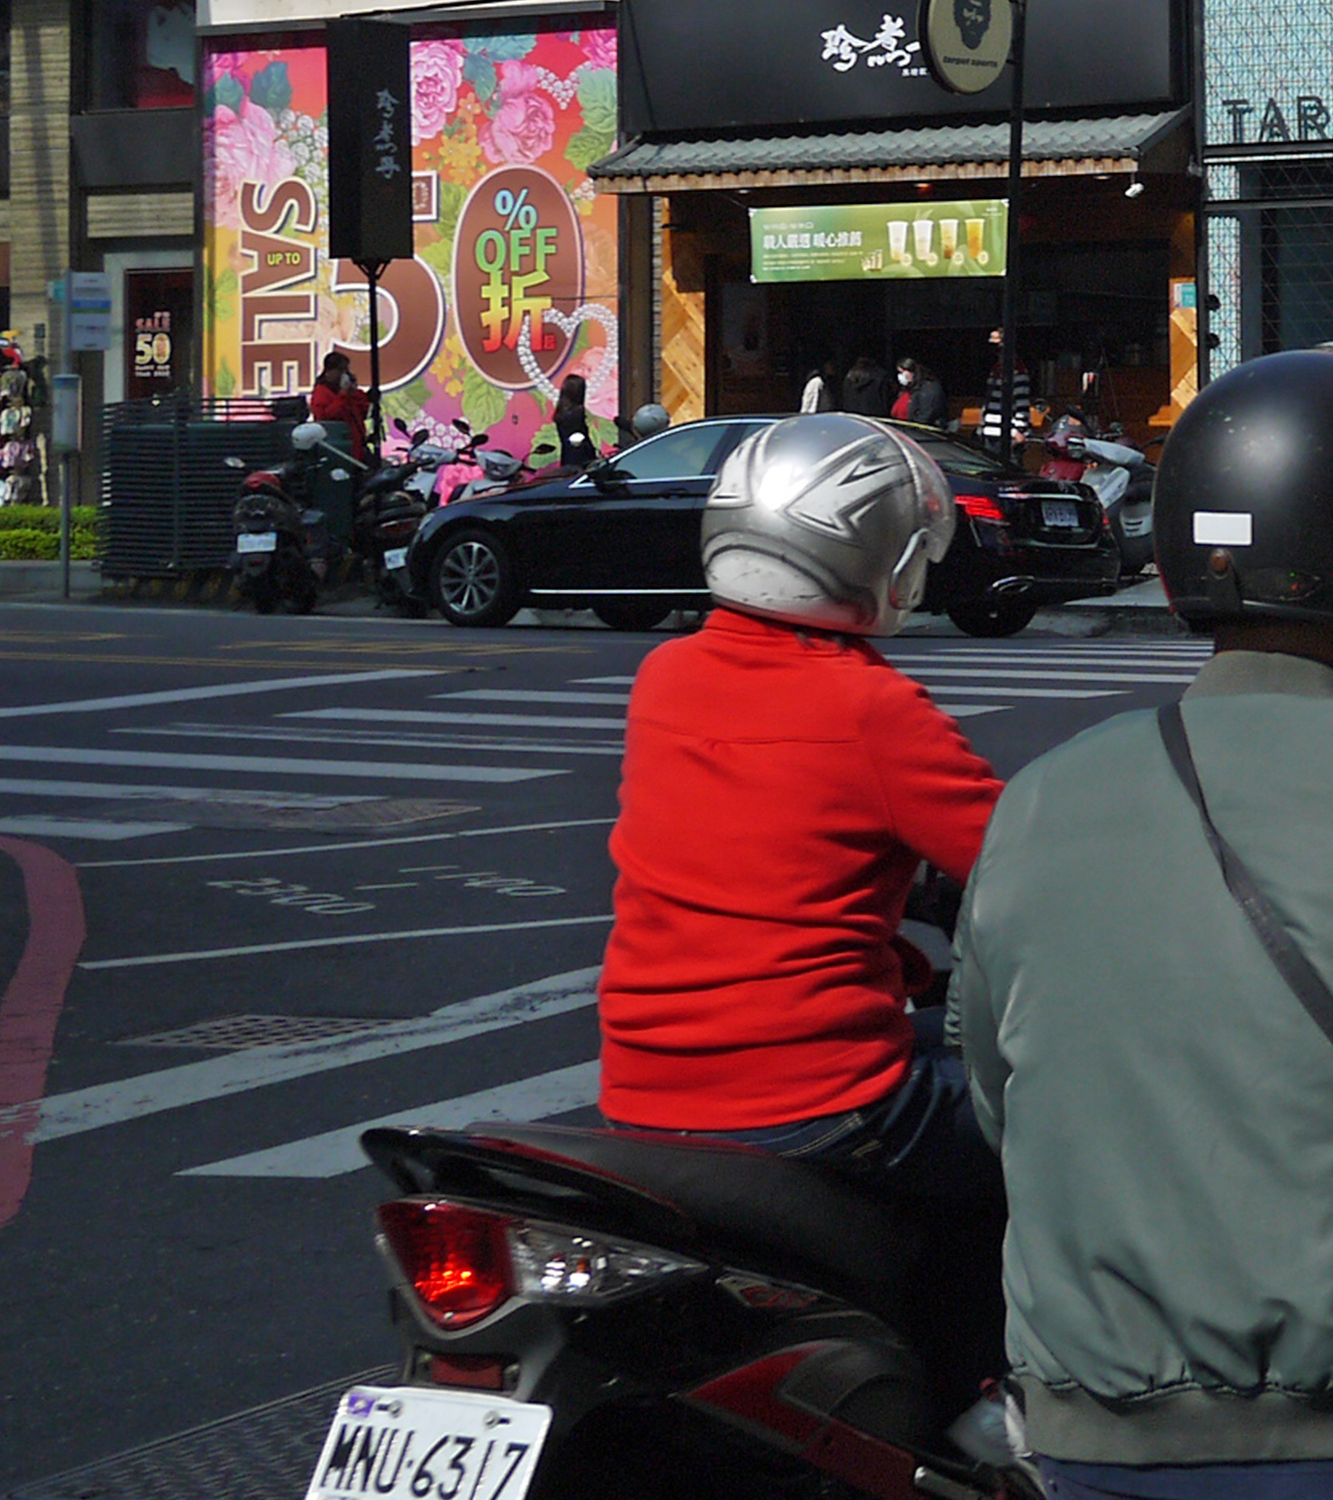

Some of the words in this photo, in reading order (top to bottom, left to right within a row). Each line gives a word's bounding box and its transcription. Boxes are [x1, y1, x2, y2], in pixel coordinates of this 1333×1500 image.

[820, 14, 921, 72] 珍煮
[267, 253, 284, 266] UP
[286, 252, 300, 265] TO
[475, 227, 557, 275] OFF
[238, 180, 318, 398] SALE
[135, 332, 170, 365] 50
